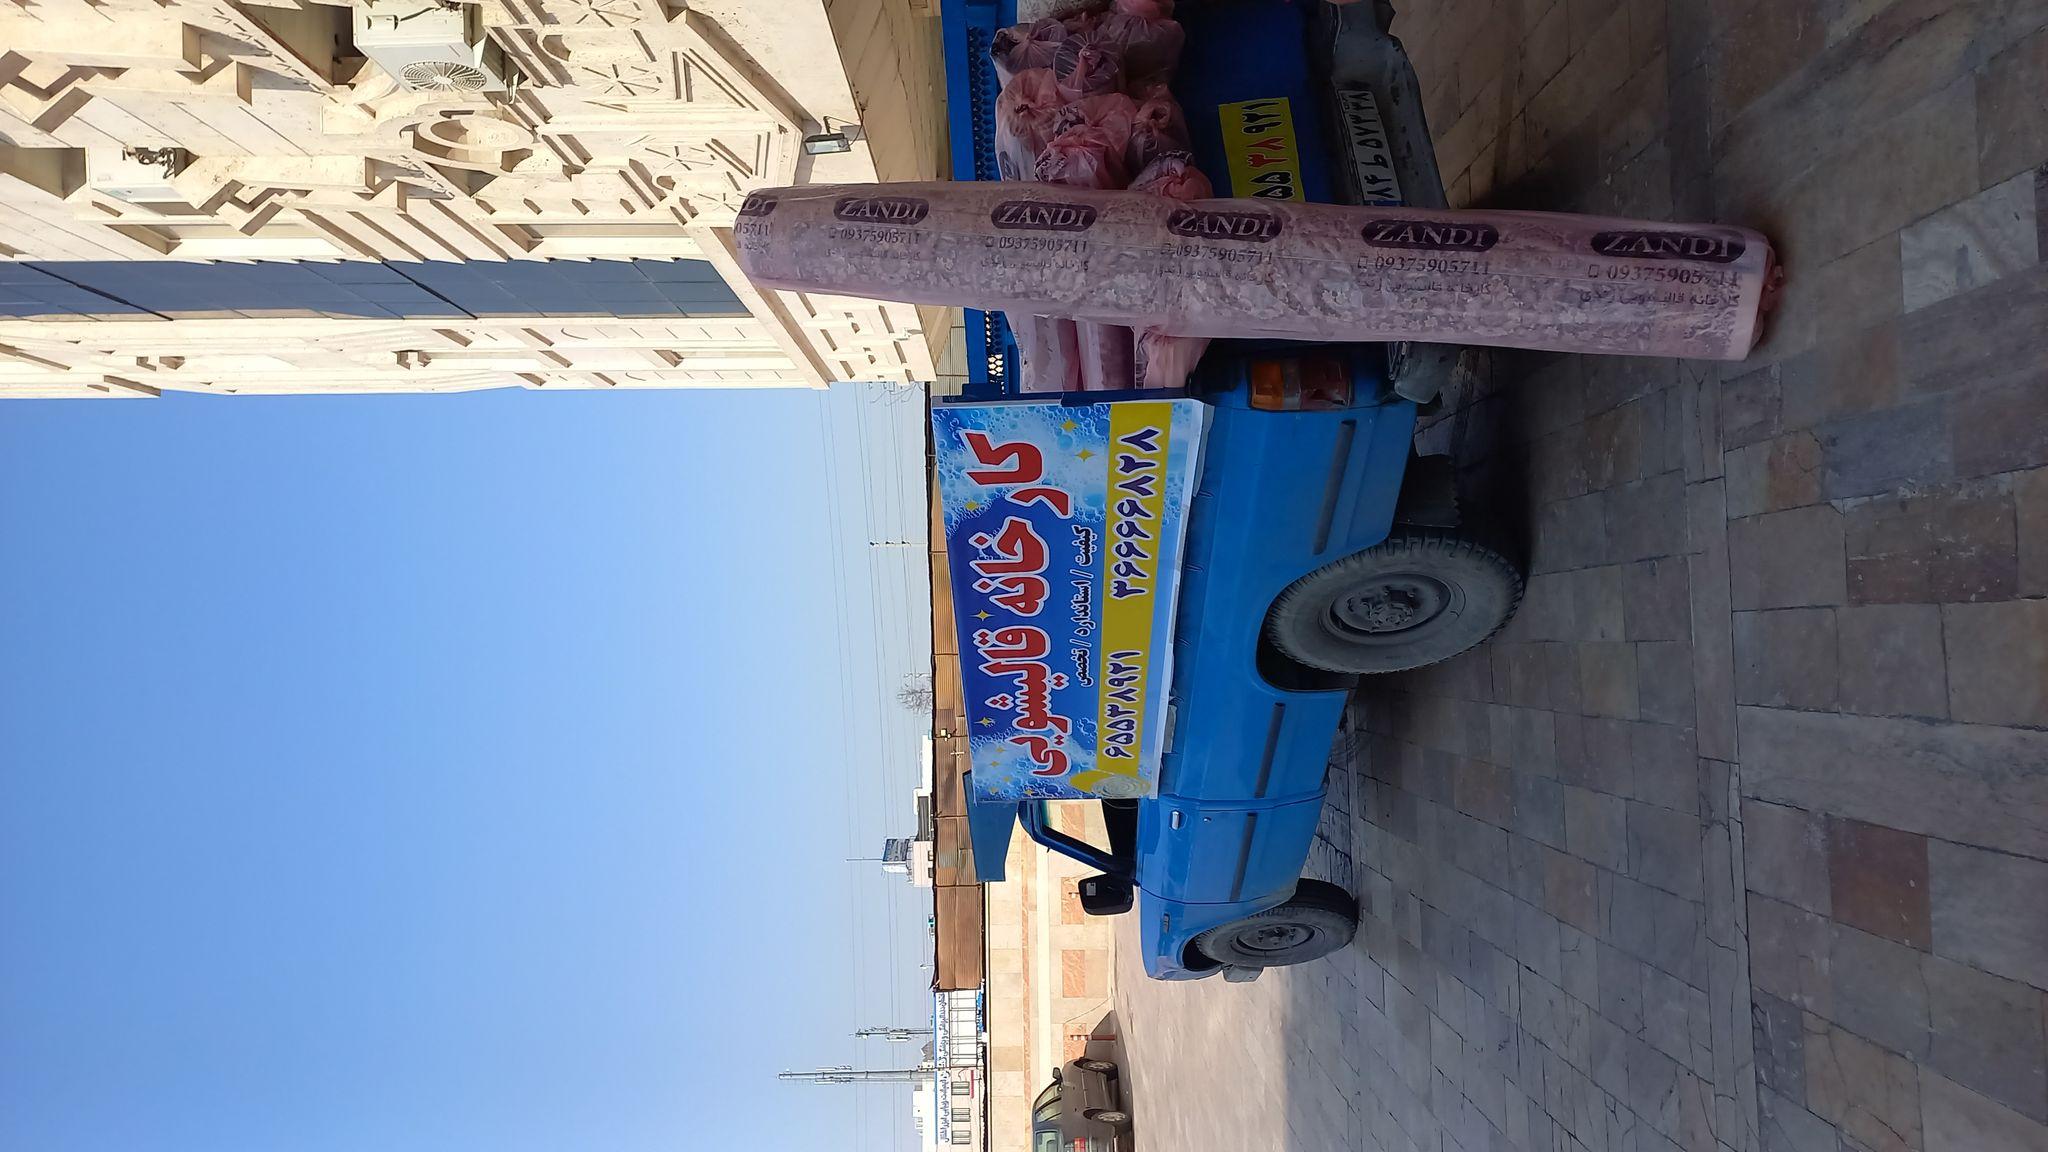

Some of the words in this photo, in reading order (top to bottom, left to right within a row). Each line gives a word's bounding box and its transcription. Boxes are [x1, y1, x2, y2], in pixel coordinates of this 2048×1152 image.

[839, 199, 924, 221] ZANDI
[998, 205, 1089, 227] ZANDI
[840, 228, 920, 245] 09375905711
[1175, 211, 1274, 237] ZANDI
[1372, 223, 1489, 247] ZANDI
[999, 236, 1088, 253] 09375905711
[1604, 234, 1732, 257] ZANDI
[961, 428, 1073, 616] کارخانه
[1072, 525, 1094, 567] کیفیت
[1071, 580, 1095, 636] استاندارد
[1072, 649, 1093, 687] تخصص
[972, 625, 1072, 777] قالیشویی
